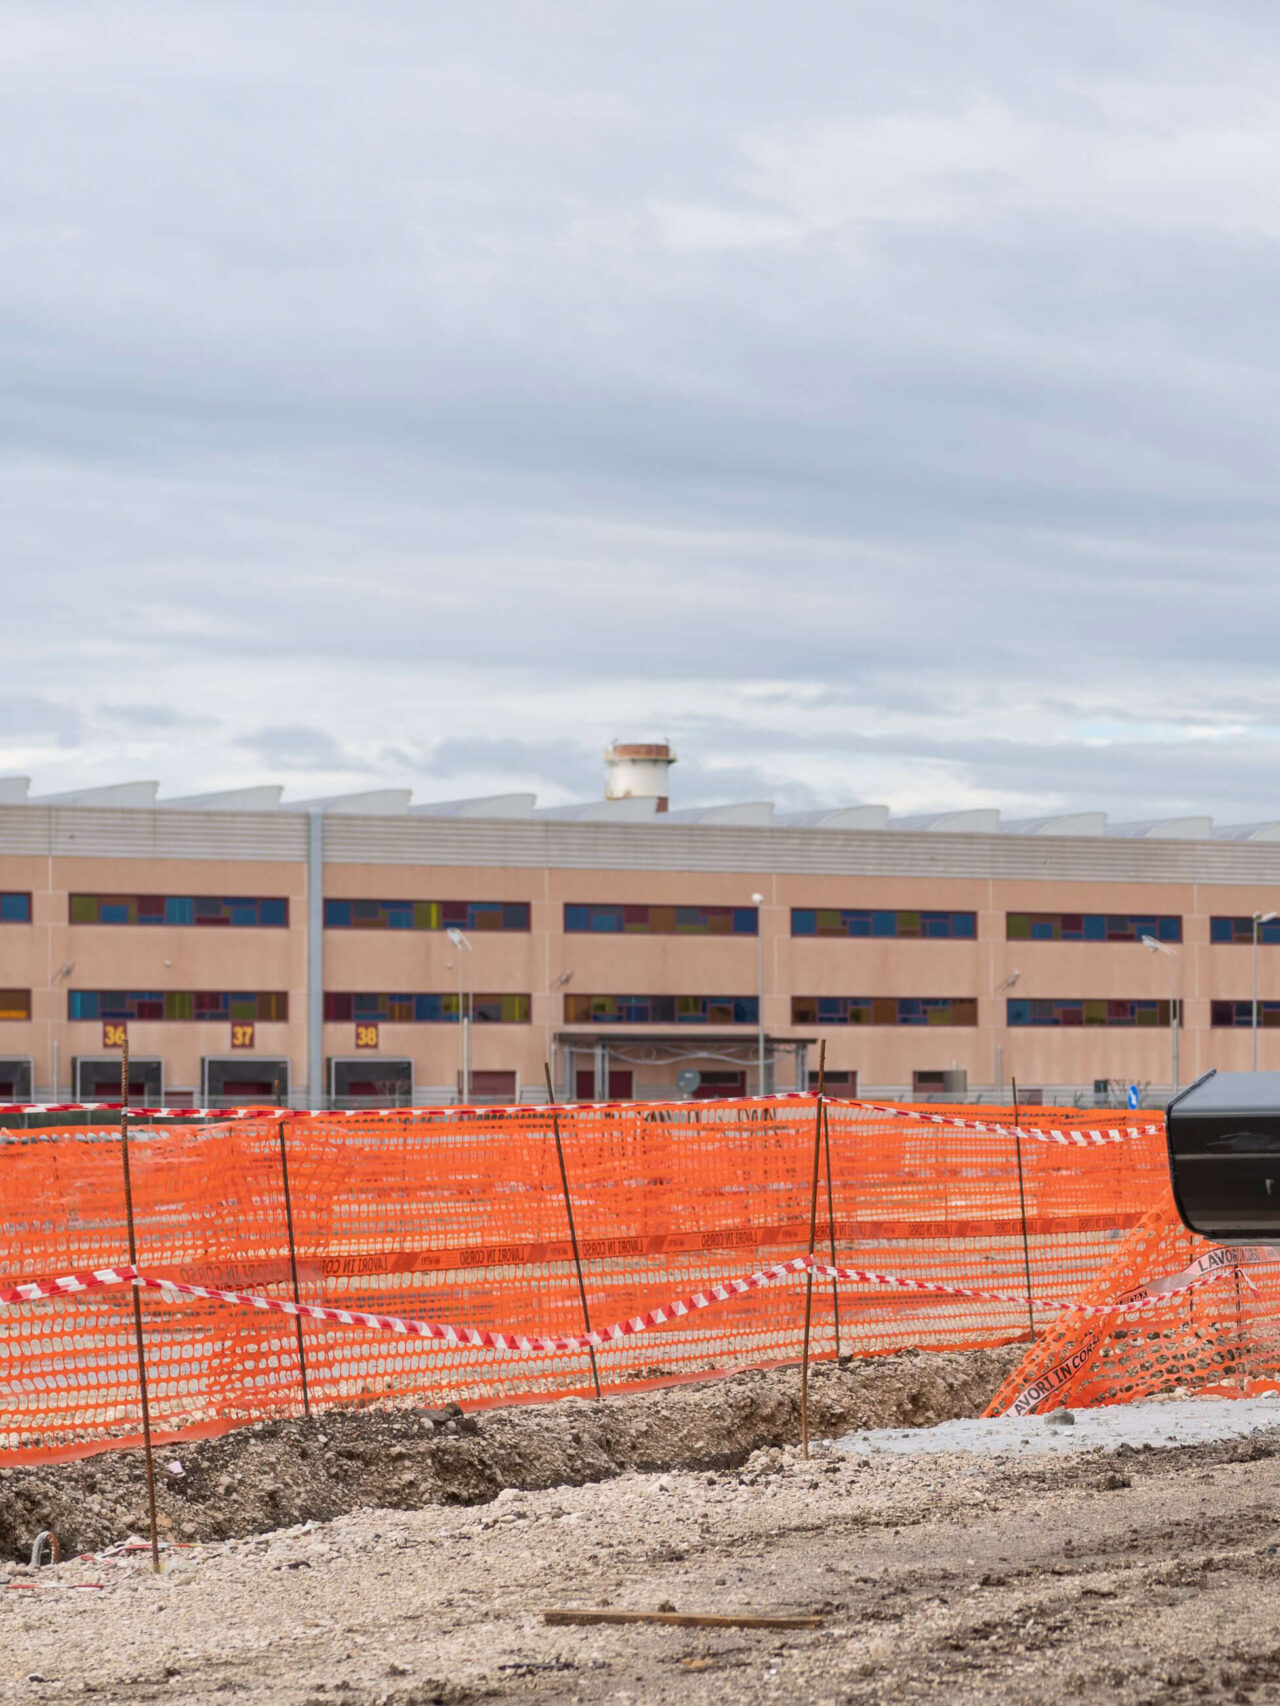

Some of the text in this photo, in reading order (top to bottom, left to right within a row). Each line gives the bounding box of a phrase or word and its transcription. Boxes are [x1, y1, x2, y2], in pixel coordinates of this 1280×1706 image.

[104, 1025, 126, 1046] 36
[232, 1026, 253, 1046] 37
[356, 1026, 378, 1046] 38
[1006, 1377, 1055, 1417] AVORI
[1053, 1365, 1073, 1384] IN
